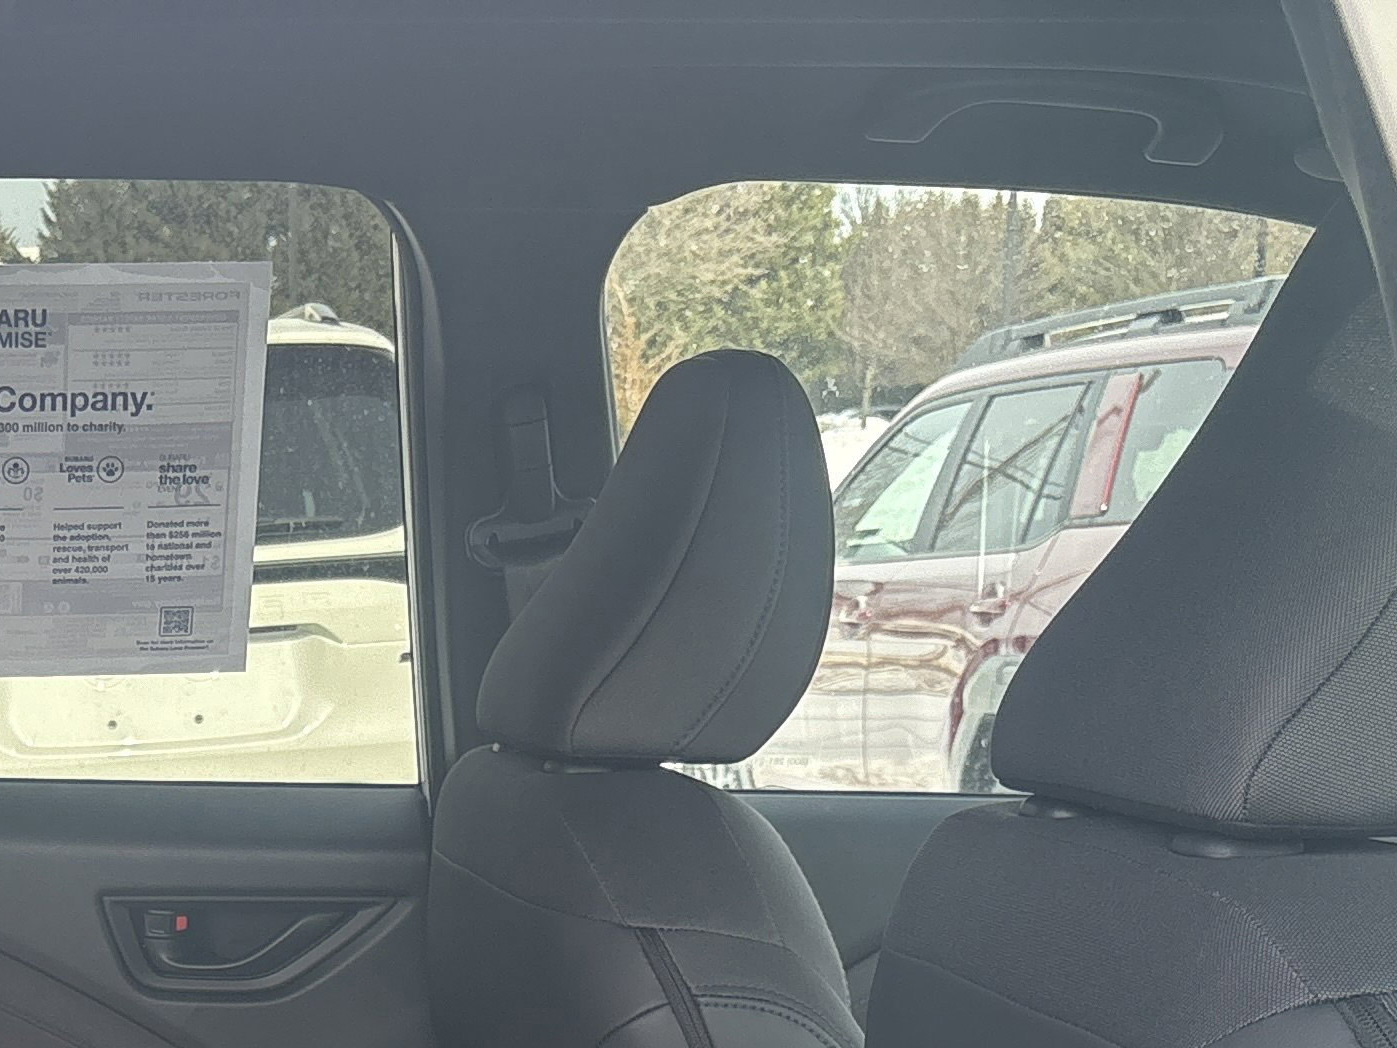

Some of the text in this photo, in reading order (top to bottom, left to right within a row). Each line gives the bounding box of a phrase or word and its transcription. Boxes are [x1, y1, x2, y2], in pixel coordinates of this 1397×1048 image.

[23, 422, 63, 433] million
[67, 423, 78, 432] to
[82, 422, 126, 435] charity.
[59, 463, 93, 473] Loves
[159, 463, 197, 473] share
[68, 474, 93, 483] Pets
[159, 474, 209, 485] the love
[53, 522, 122, 531] Helped support
[88, 544, 129, 553] transport
[72, 555, 99, 563] health
